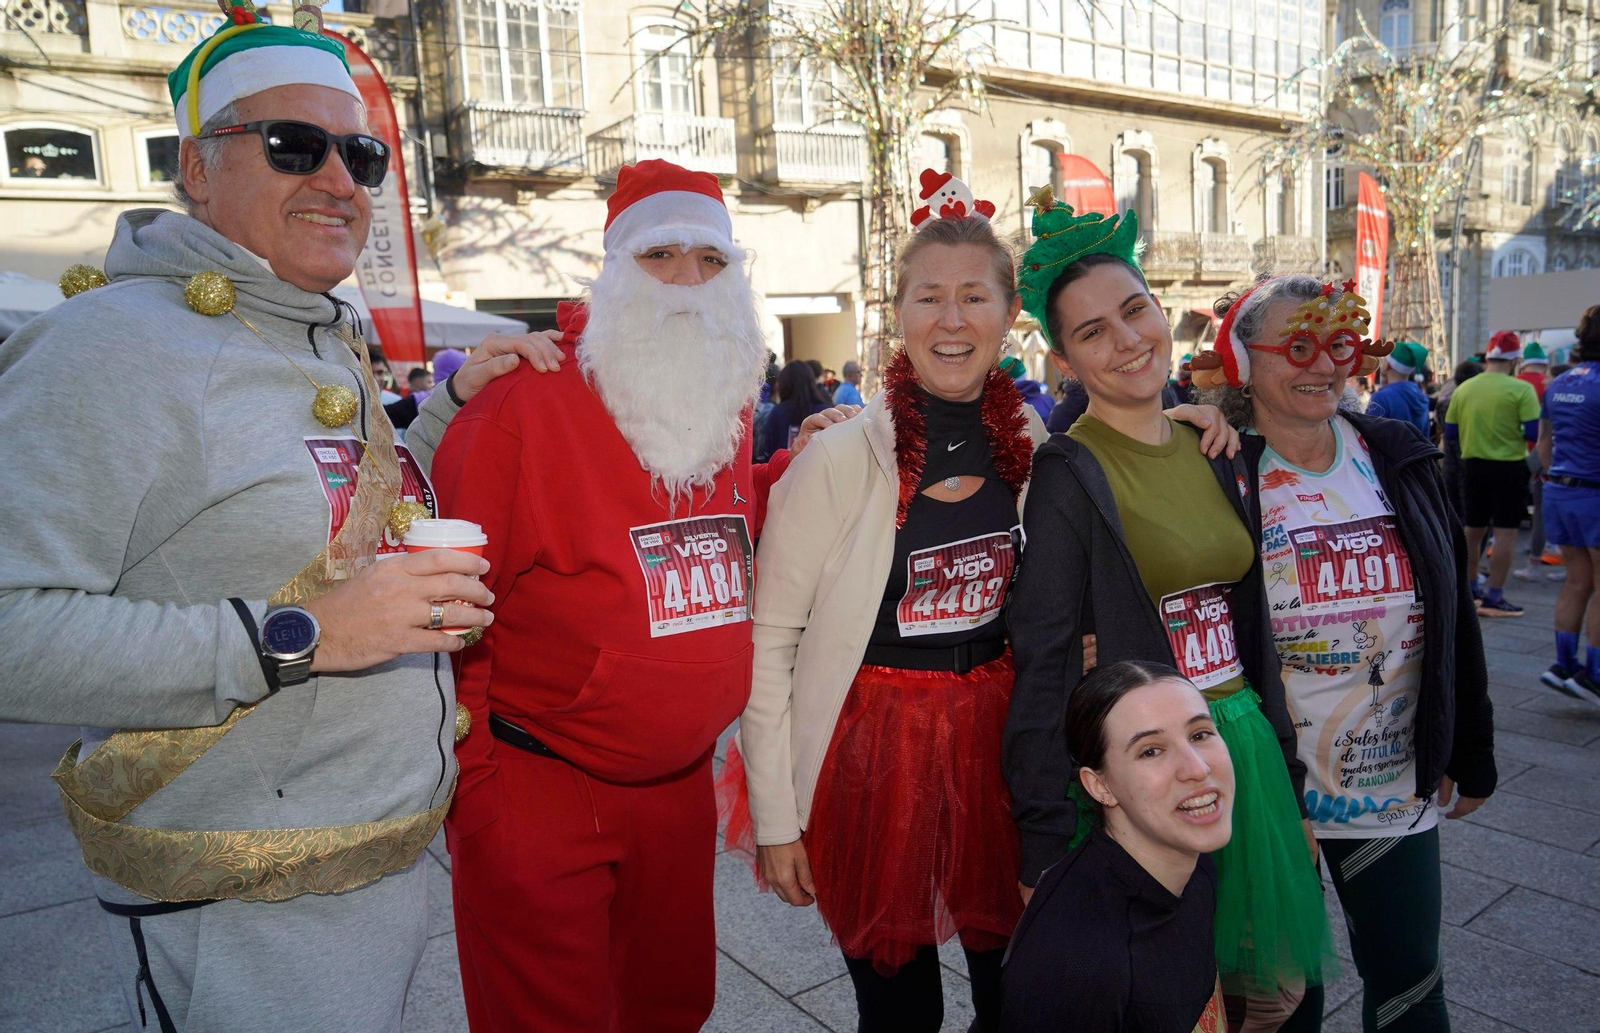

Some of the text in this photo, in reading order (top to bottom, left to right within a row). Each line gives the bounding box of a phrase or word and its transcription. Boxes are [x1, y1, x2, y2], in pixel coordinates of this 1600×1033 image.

[1262, 523, 1284, 542] ETA
[1266, 533, 1289, 552] PAS
[673, 538, 728, 560] vigo
[1327, 534, 1383, 554] vigo
[943, 557, 995, 580] vigo
[1317, 553, 1400, 597] 4491
[663, 561, 744, 612] 4484
[912, 577, 1003, 616] 4483
[1194, 601, 1229, 622] vigo
[1272, 601, 1288, 611] si
[1270, 606, 1387, 633] OTIVACION
[1307, 651, 1361, 665] LIEBRE
[1294, 717, 1313, 729] ends
[1381, 726, 1400, 744] hoy
[1341, 747, 1358, 763] de
[1361, 740, 1405, 760] TITULAR
[1341, 761, 1374, 777] quedas
[1340, 775, 1354, 788] el
